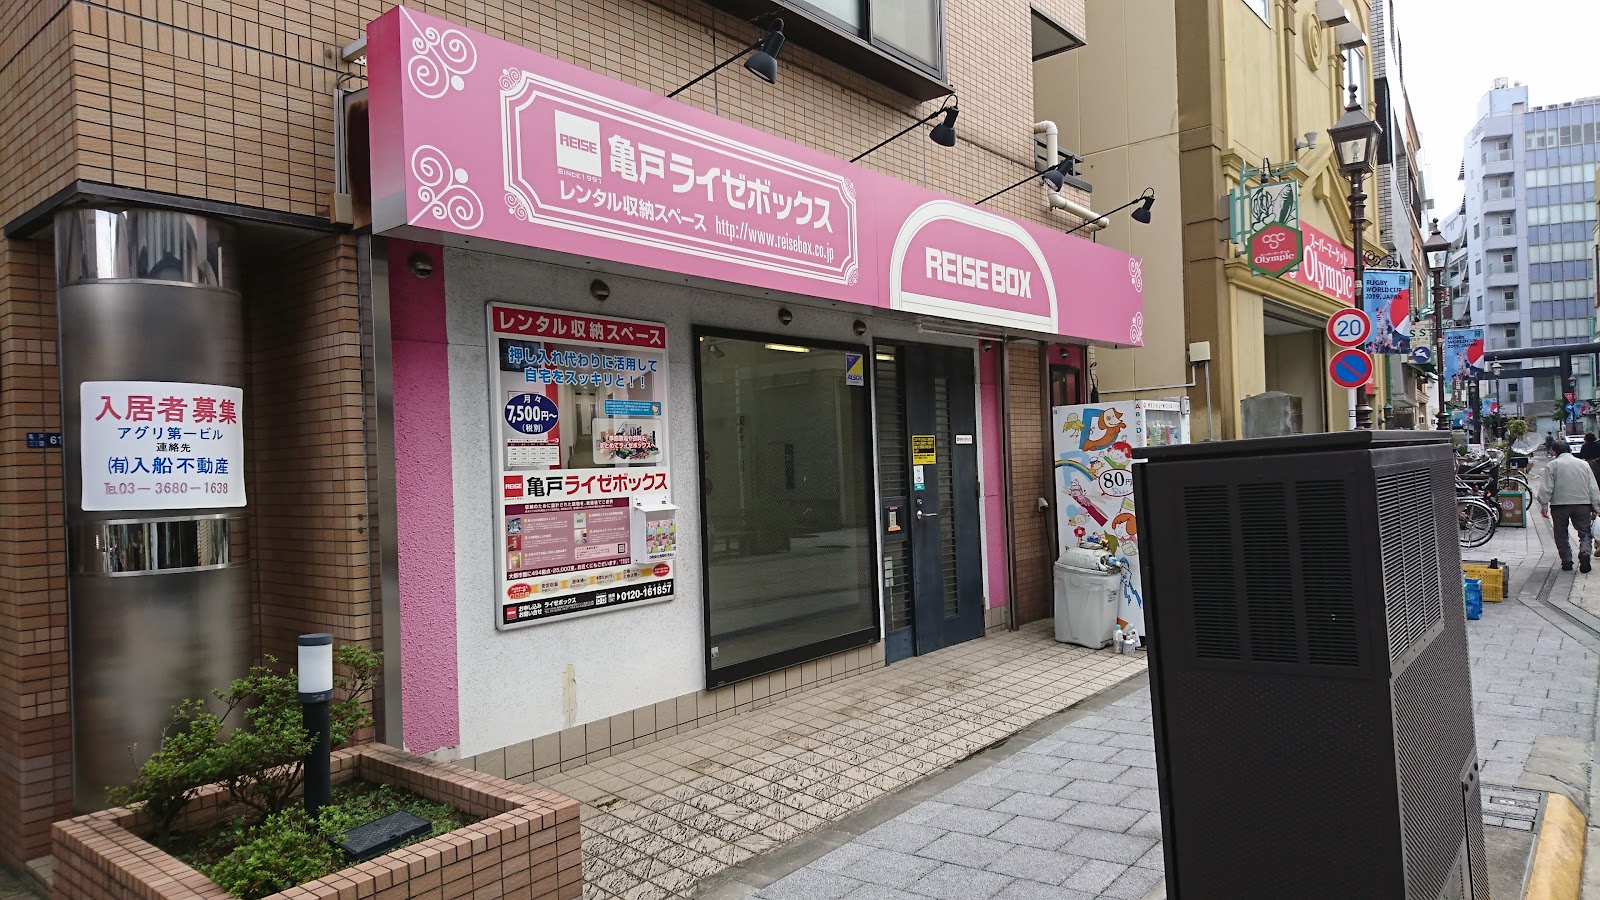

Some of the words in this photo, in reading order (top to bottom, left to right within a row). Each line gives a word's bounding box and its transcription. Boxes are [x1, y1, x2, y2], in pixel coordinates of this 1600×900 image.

[560, 133, 597, 154] REISE
[608, 134, 833, 233] 亀戸ライゼボックス
[560, 180, 706, 233] レンタル収納スペース
[715, 216, 834, 263] http://www.reisebox.co.jp
[1310, 233, 1347, 266] スーパーマーケット
[1254, 253, 1294, 264] Olympic
[925, 246, 988, 290] REISE
[991, 262, 1032, 298] BOX
[1303, 246, 1352, 298] Olympic
[500, 311, 662, 346] レンタル収納スペース
[1337, 319, 1361, 337] 20
[508, 346, 658, 372] 押し入れ代わりに活用して
[95, 395, 236, 425] 入居者募集
[523, 395, 542, 404] 月々
[117, 426, 224, 440] アグリ第一ビル
[156, 442, 191, 453] 連絡先
[526, 472, 668, 497] 亀戸ライゼボックス
[621, 584, 672, 600] 0120-161857
